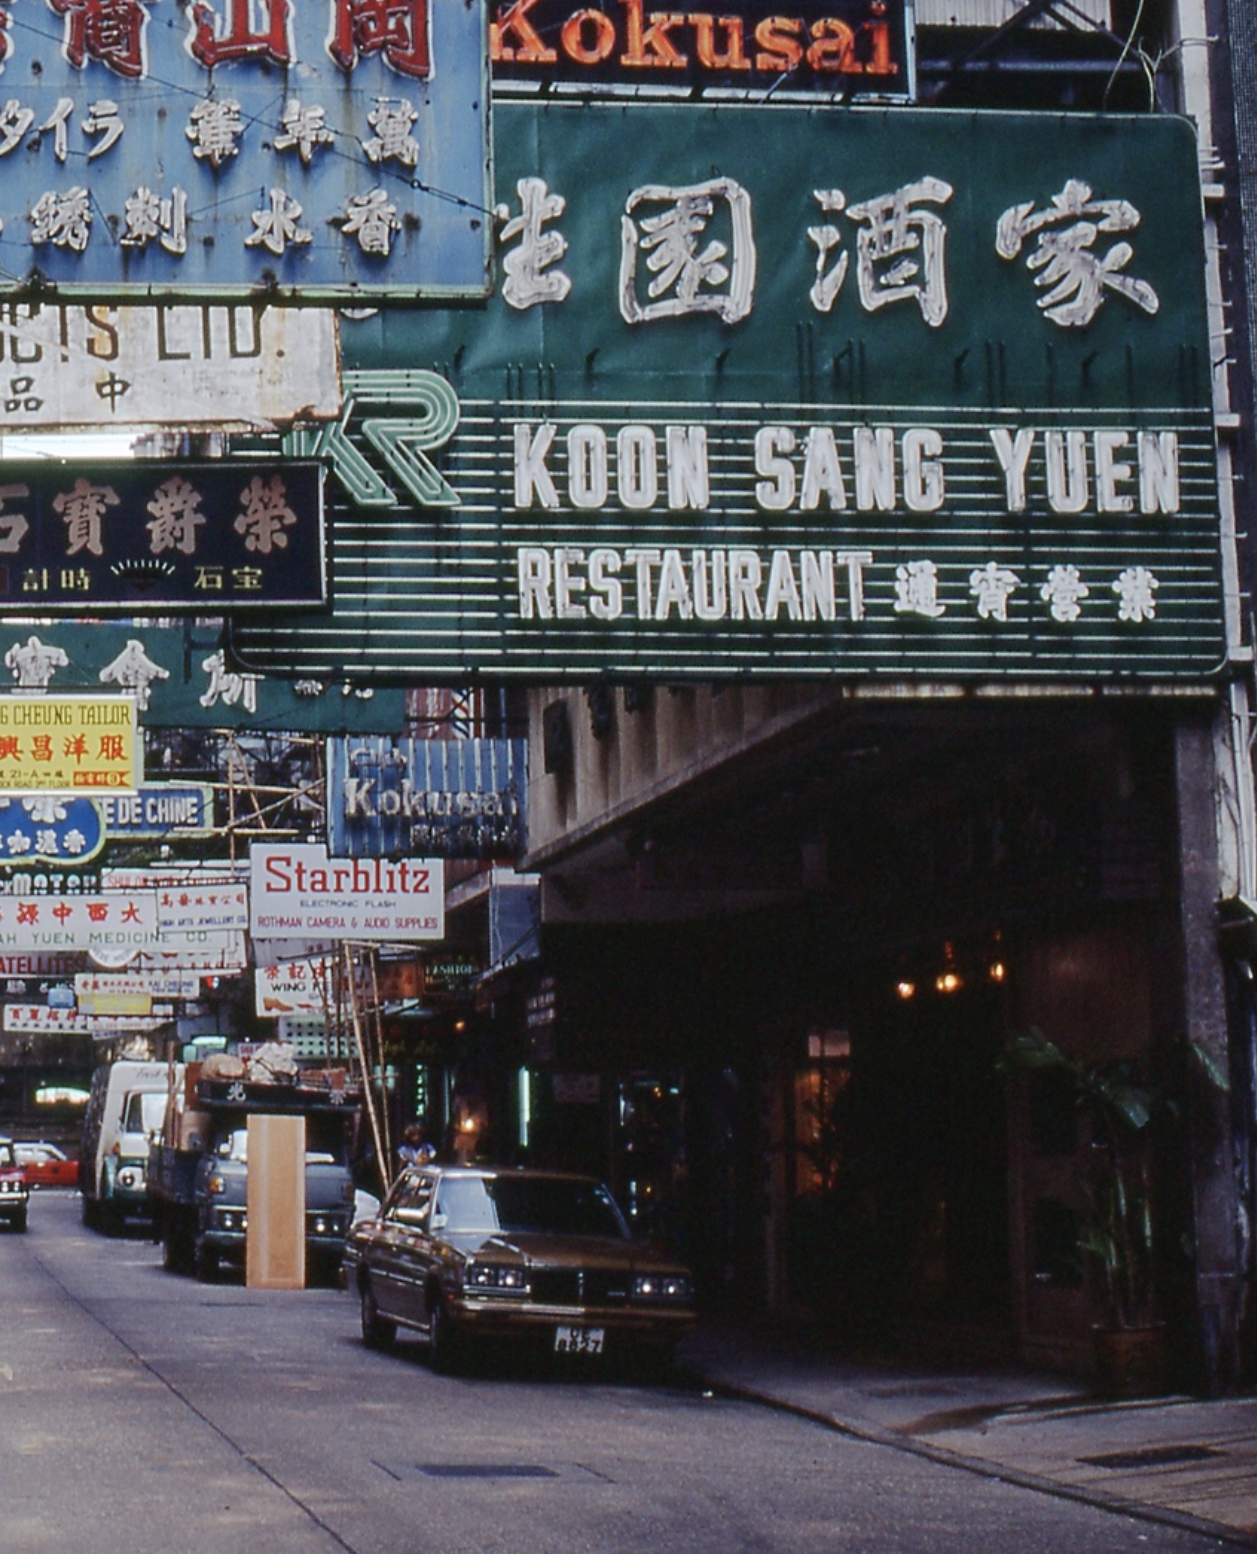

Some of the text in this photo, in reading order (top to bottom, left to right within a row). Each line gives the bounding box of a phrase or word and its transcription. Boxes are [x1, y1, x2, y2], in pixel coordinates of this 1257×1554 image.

[490, 0, 899, 75] Kokusai
[157, 305, 286, 363] LTD.
[513, 424, 1181, 513] KOON SANG YUEN
[517, 548, 873, 621] RESTAURANT
[13, 704, 72, 725] CHEUNG
[78, 704, 131, 725] TAILOR
[118, 797, 142, 823] DE
[146, 797, 198, 823] CHINE
[344, 777, 517, 816] Kokusai
[265, 856, 430, 895] Starblitz
[300, 900, 396, 909] ELECTRONIC FLASH
[33, 932, 75, 945] YUEN
[89, 931, 170, 944] MEDICINE
[257, 917, 303, 929] ROTHMAN
[306, 917, 345, 929] CAMERA
[364, 917, 390, 929] AUDIO
[395, 917, 438, 930] SUPPLIES
[271, 982, 306, 993] WING
